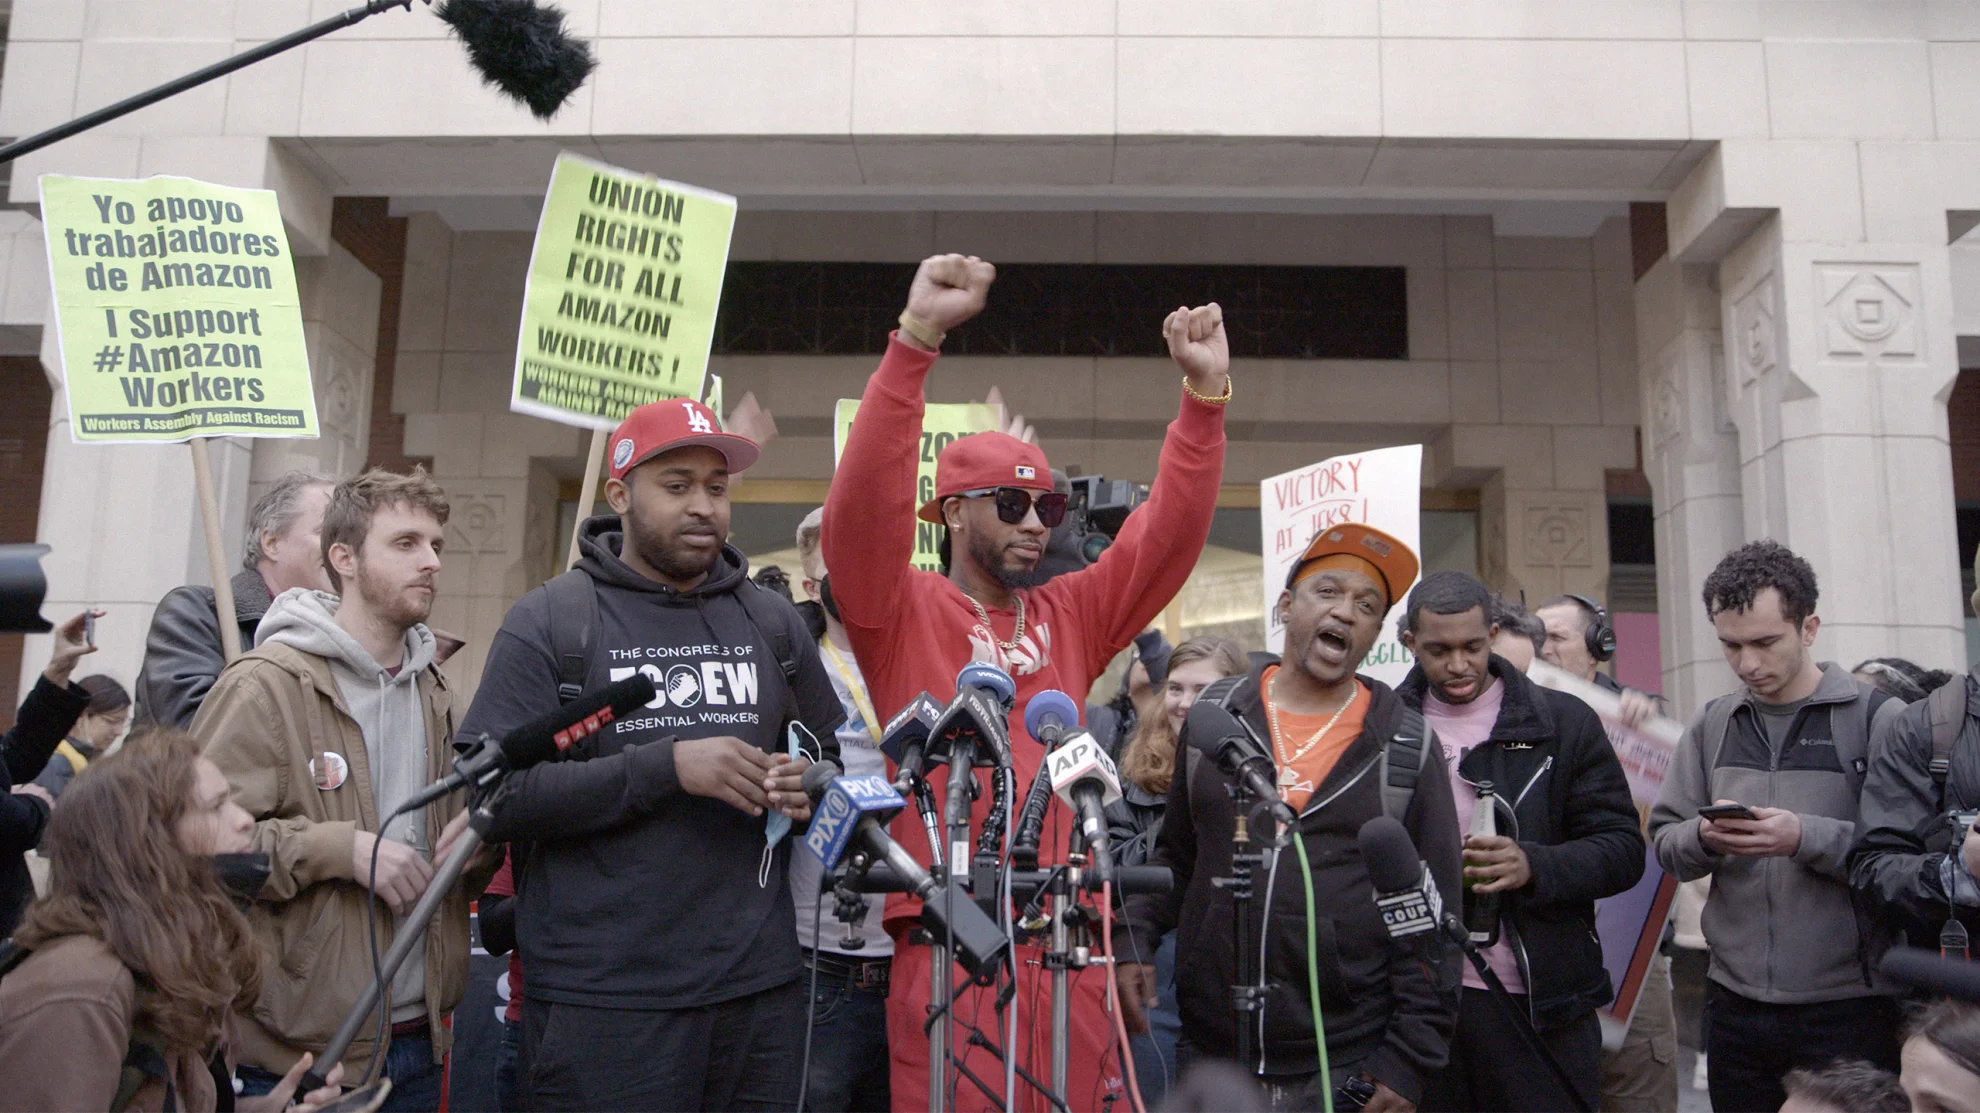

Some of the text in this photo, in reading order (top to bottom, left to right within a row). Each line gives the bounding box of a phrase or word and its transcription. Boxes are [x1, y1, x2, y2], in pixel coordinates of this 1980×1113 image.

[92, 194, 244, 225] Yo apoyo
[588, 174, 684, 225] UNION
[65, 225, 280, 259] trabajadores
[574, 211, 683, 266] RIGHTS
[85, 261, 272, 292] de Amazon
[566, 251, 683, 308] FOR ALL
[105, 308, 262, 339] I Support
[557, 290, 671, 341] AMAZON
[93, 343, 262, 373] #Amazon
[538, 325, 663, 377] WORKERS
[119, 372, 265, 408] Workers
[84, 410, 300, 431] Workers Assembly Against Racism
[682, 403, 712, 433] LA
[1275, 458, 1362, 512] VICTORY
[1276, 527, 1295, 554] AT
[610, 645, 753, 660] THE CONGRESS OF
[616, 716, 696, 733] ESSENTIAL
[699, 712, 759, 724] WORKERS
[1054, 744, 1088, 777] AP
[1383, 904, 1428, 924] COUP
